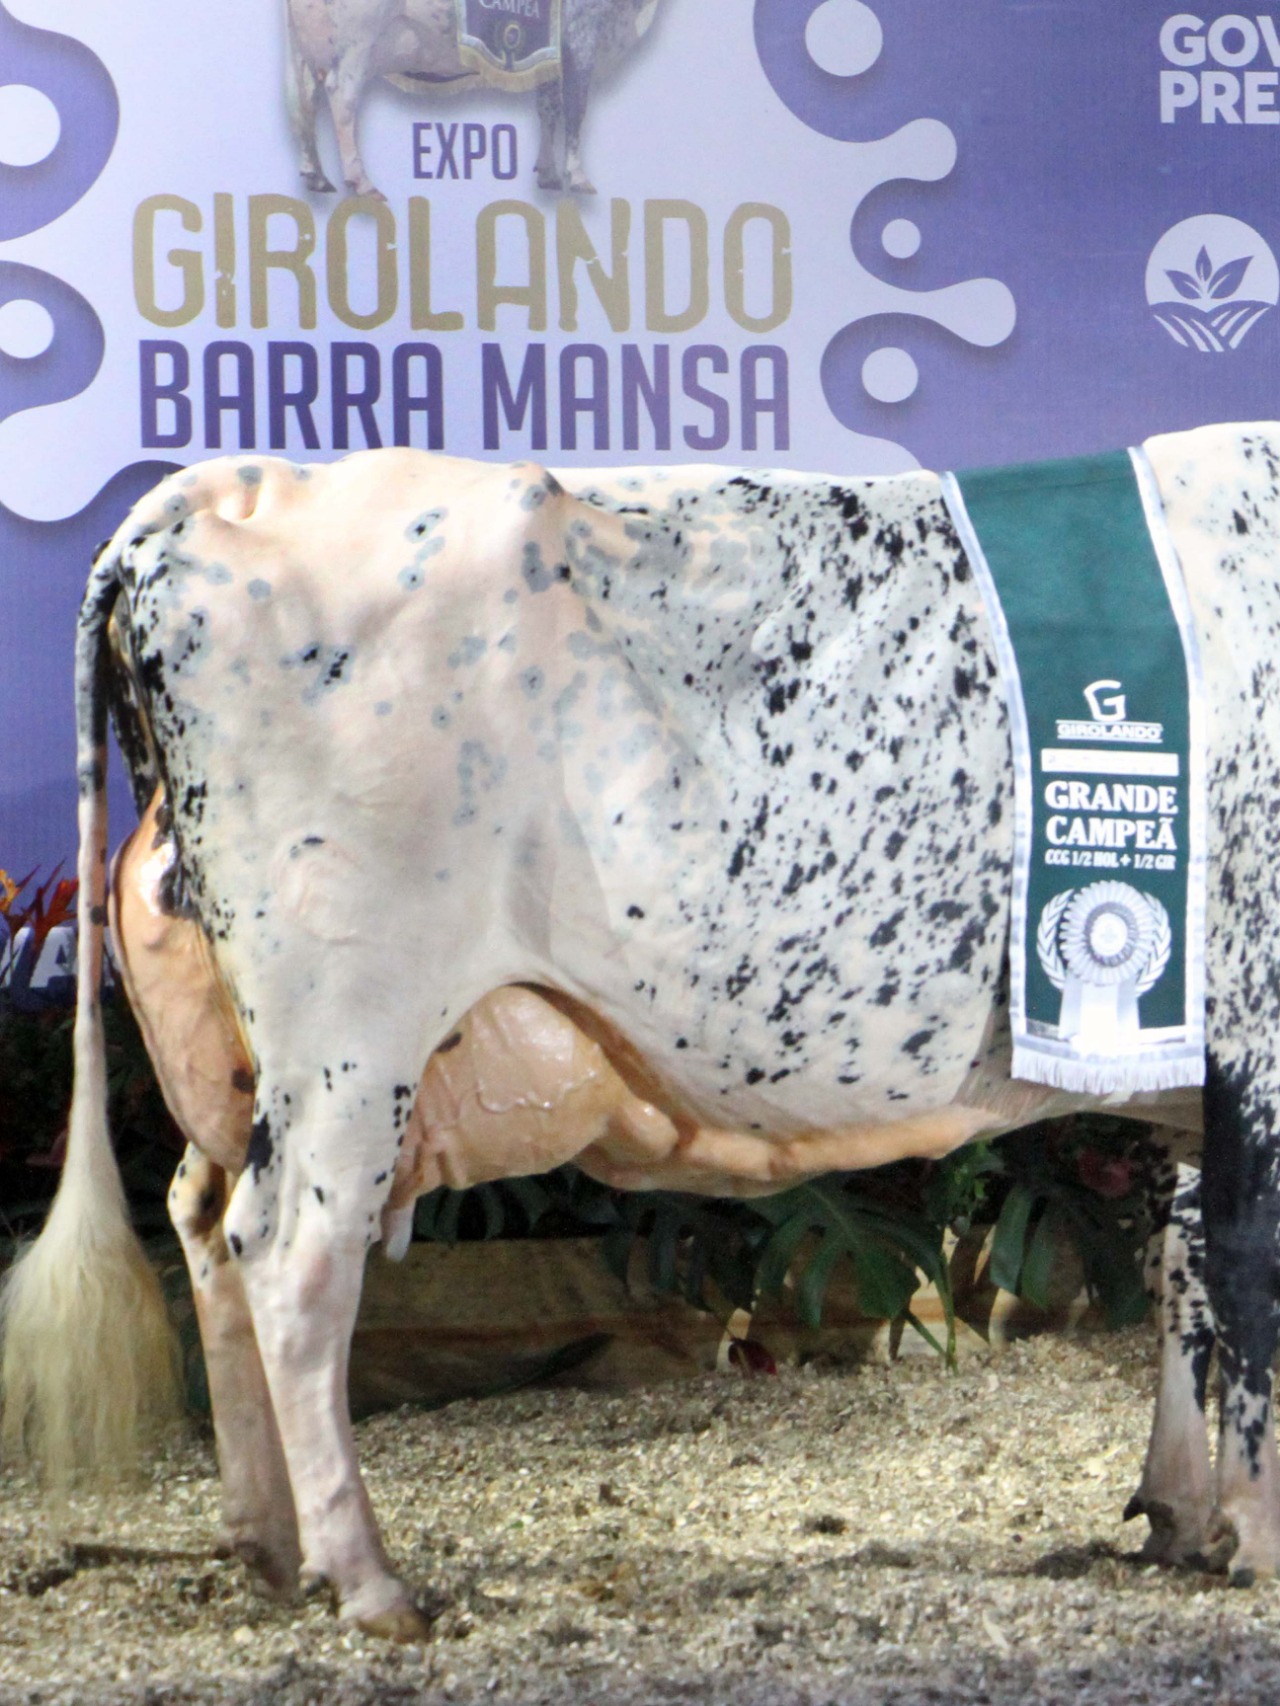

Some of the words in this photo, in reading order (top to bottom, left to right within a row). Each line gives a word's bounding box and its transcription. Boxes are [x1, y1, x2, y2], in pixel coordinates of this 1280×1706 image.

[412, 122, 518, 181] EXPO
[131, 192, 794, 333] GIROLANDO
[139, 340, 445, 450] BARRA
[481, 343, 791, 451] MANSA
[1057, 723, 1162, 739] GIROLANDO
[1044, 780, 1179, 815] GRANDE
[1045, 815, 1178, 850] CAMPEÃ
[1071, 850, 1093, 867] 1/2
[1133, 854, 1154, 869] 1/2
